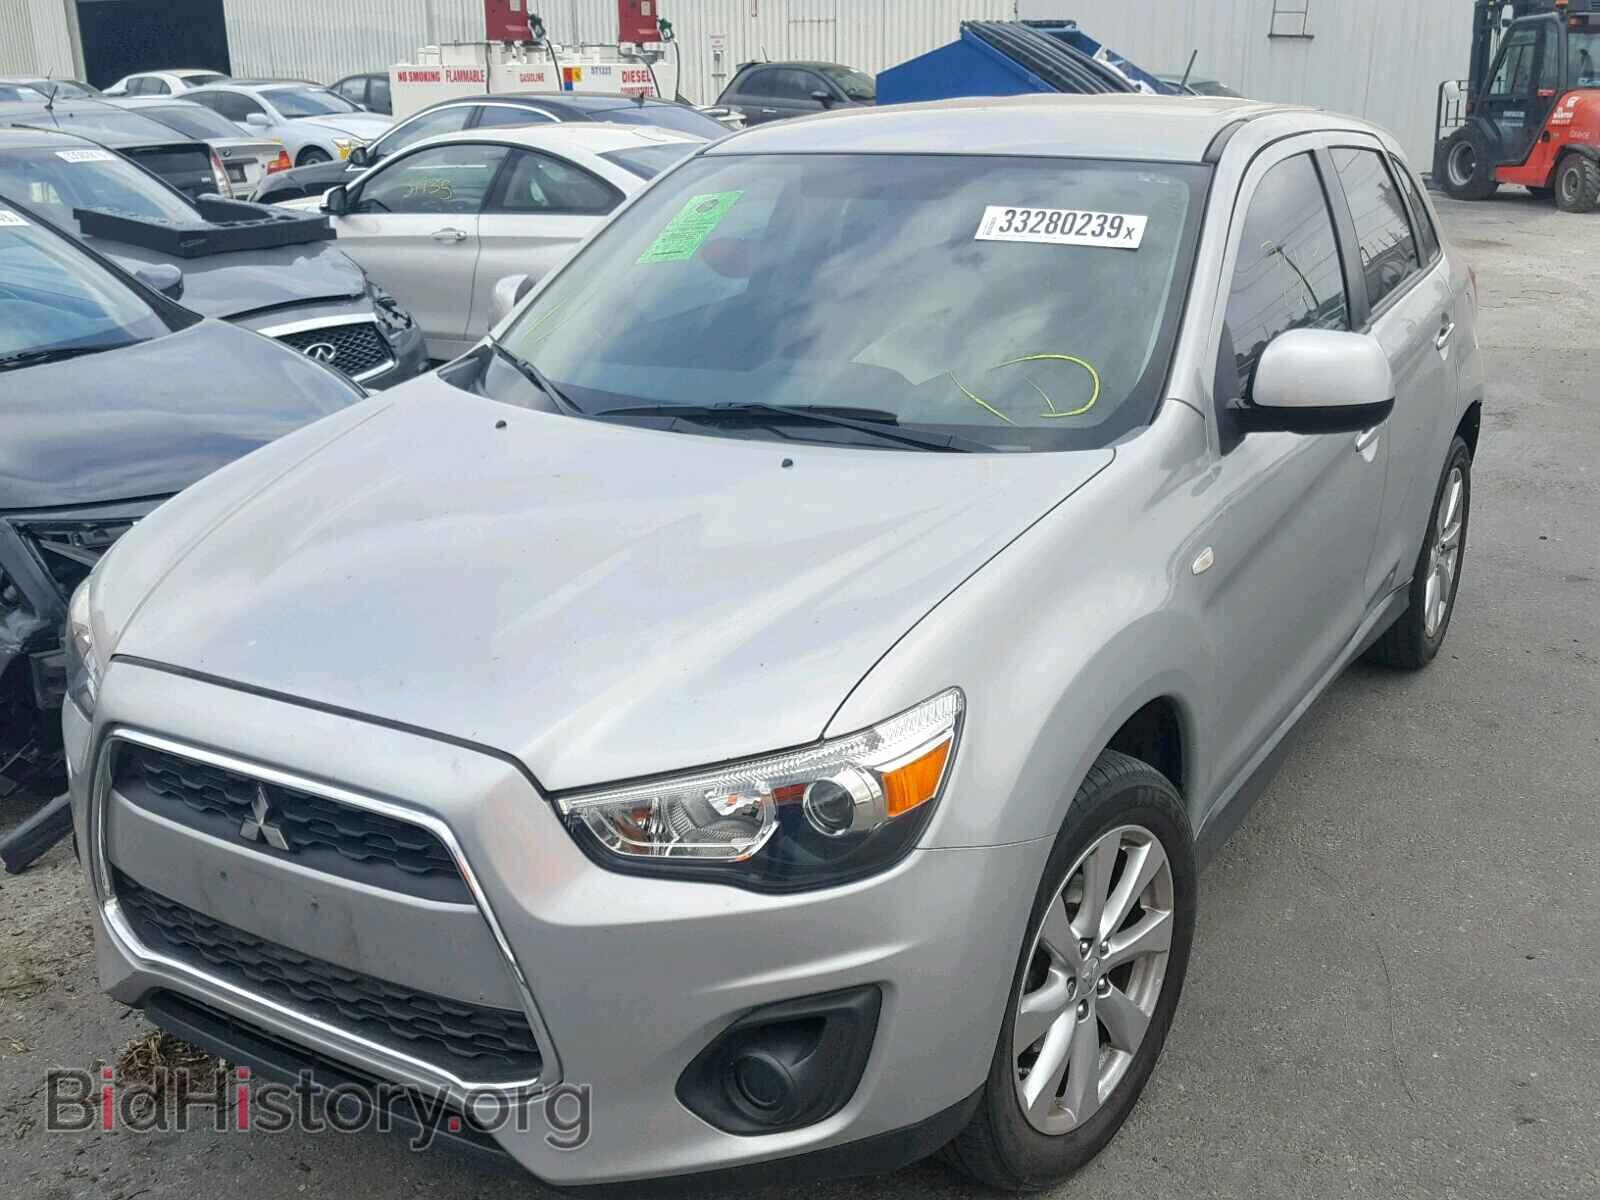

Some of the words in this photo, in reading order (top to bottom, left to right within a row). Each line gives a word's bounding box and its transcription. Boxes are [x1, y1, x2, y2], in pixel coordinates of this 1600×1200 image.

[397, 71, 407, 82] NO
[408, 71, 441, 82] SMOKING
[446, 69, 485, 82] FLAMMABLE
[520, 72, 545, 83] GASOLINE
[622, 69, 652, 83] DIESEL
[999, 209, 1125, 239] 33280239
